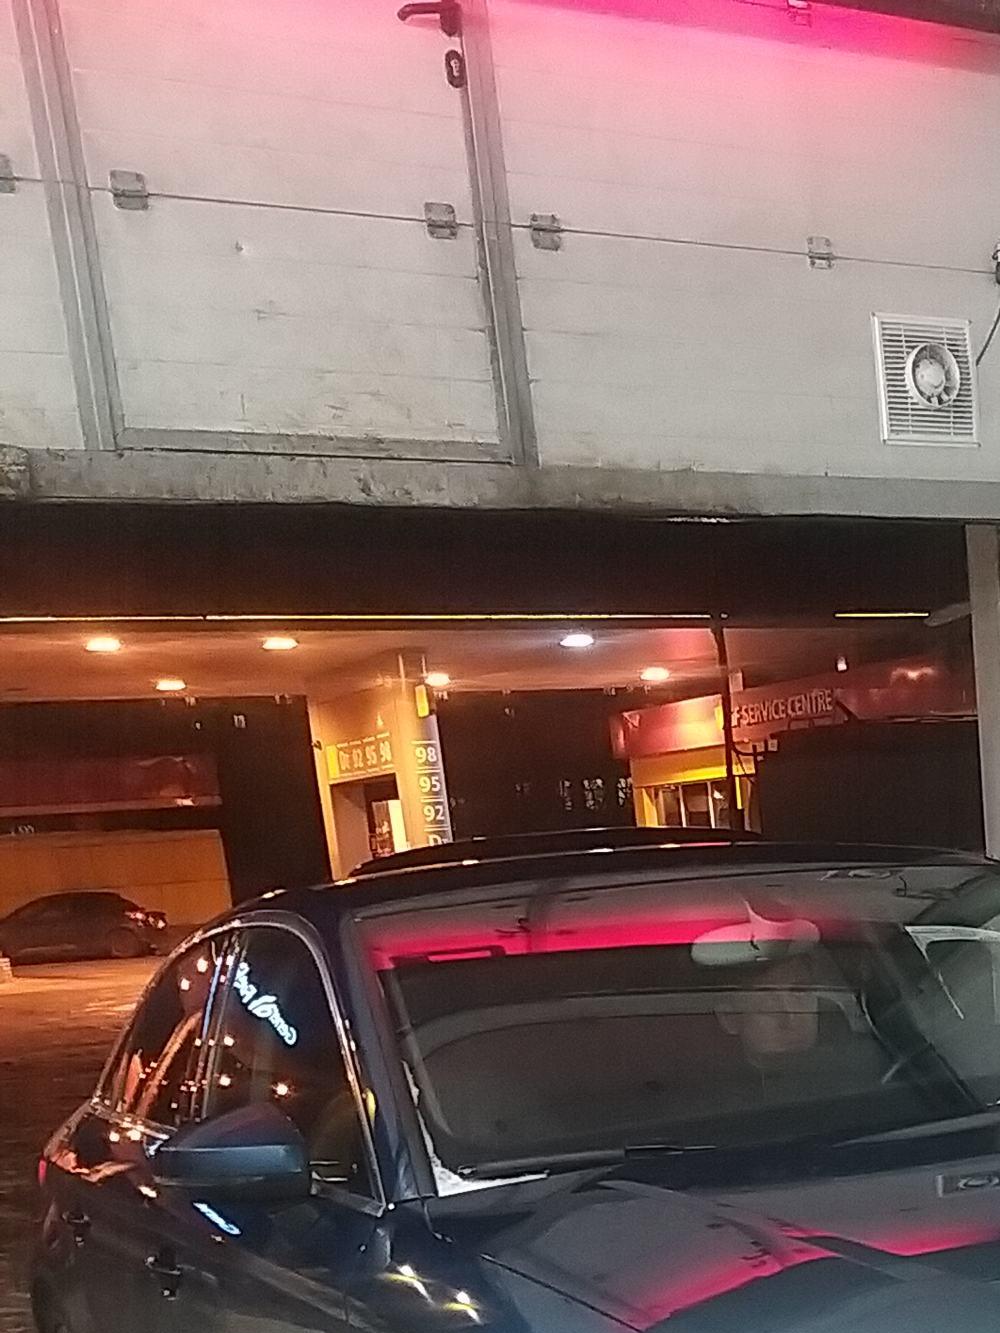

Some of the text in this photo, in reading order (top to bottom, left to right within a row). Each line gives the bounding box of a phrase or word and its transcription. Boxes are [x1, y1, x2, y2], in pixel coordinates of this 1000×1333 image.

[787, 688, 834, 718] CENTRE
[415, 747, 437, 764] 98
[419, 776, 441, 793] 95
[423, 805, 445, 823] 92
